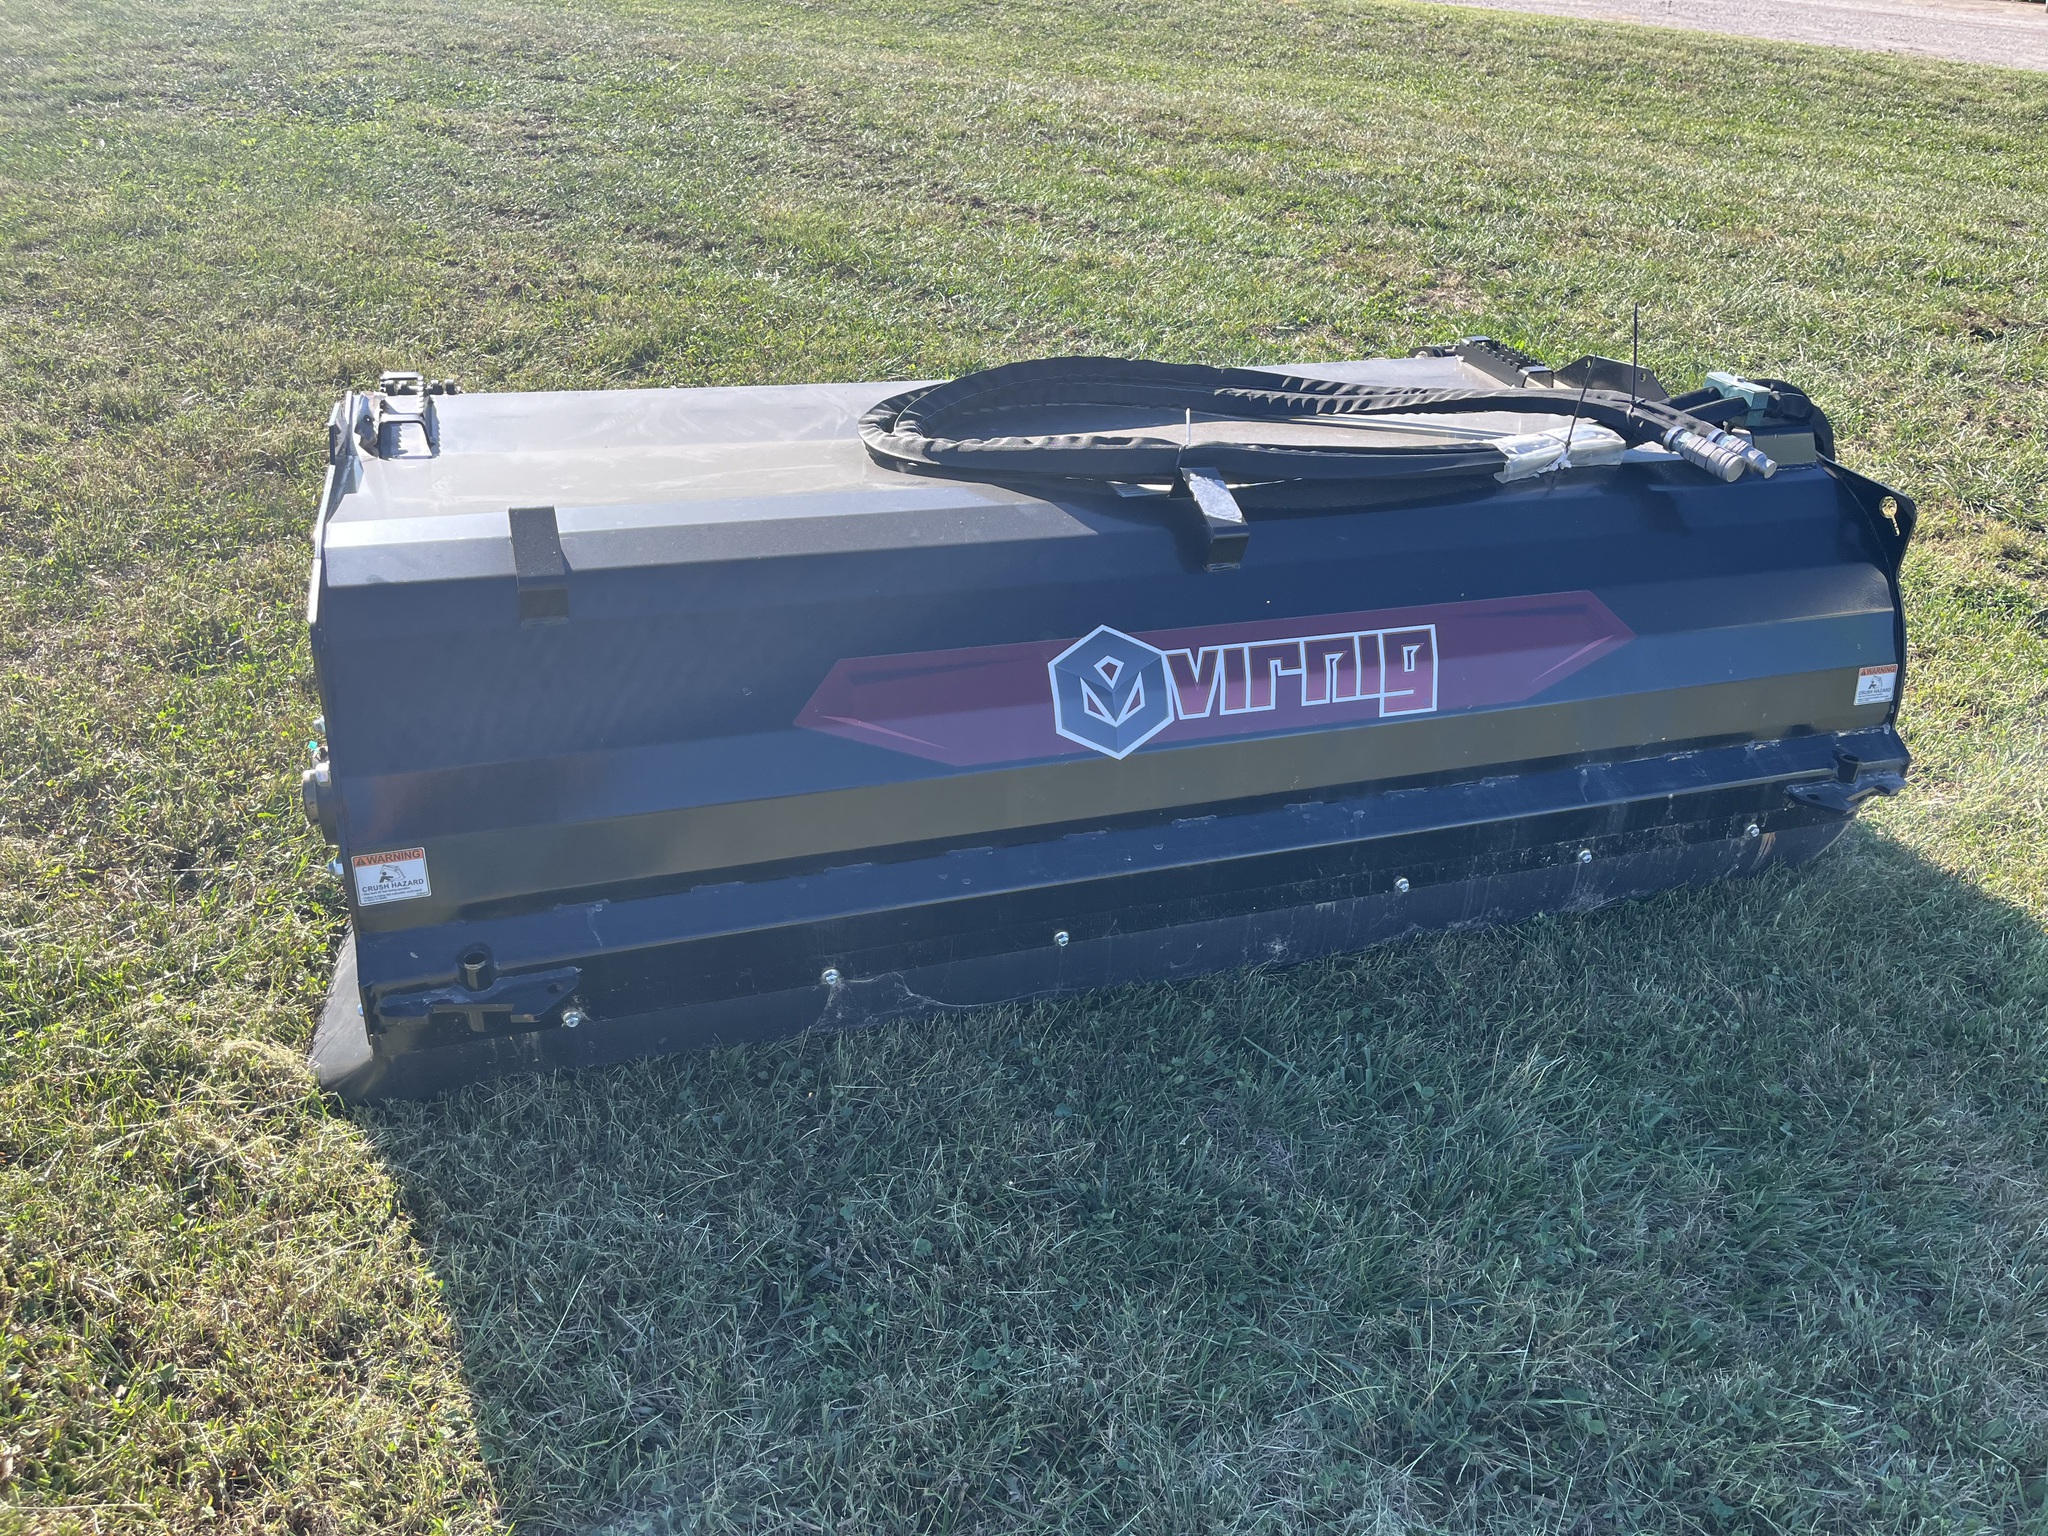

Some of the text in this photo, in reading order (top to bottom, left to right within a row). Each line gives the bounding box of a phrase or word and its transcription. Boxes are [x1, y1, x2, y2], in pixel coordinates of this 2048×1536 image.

[1866, 666, 1895, 675] WARNING
[366, 850, 421, 864] WARNING
[362, 883, 390, 893] CRUSH
[391, 878, 424, 888] HAZARD
